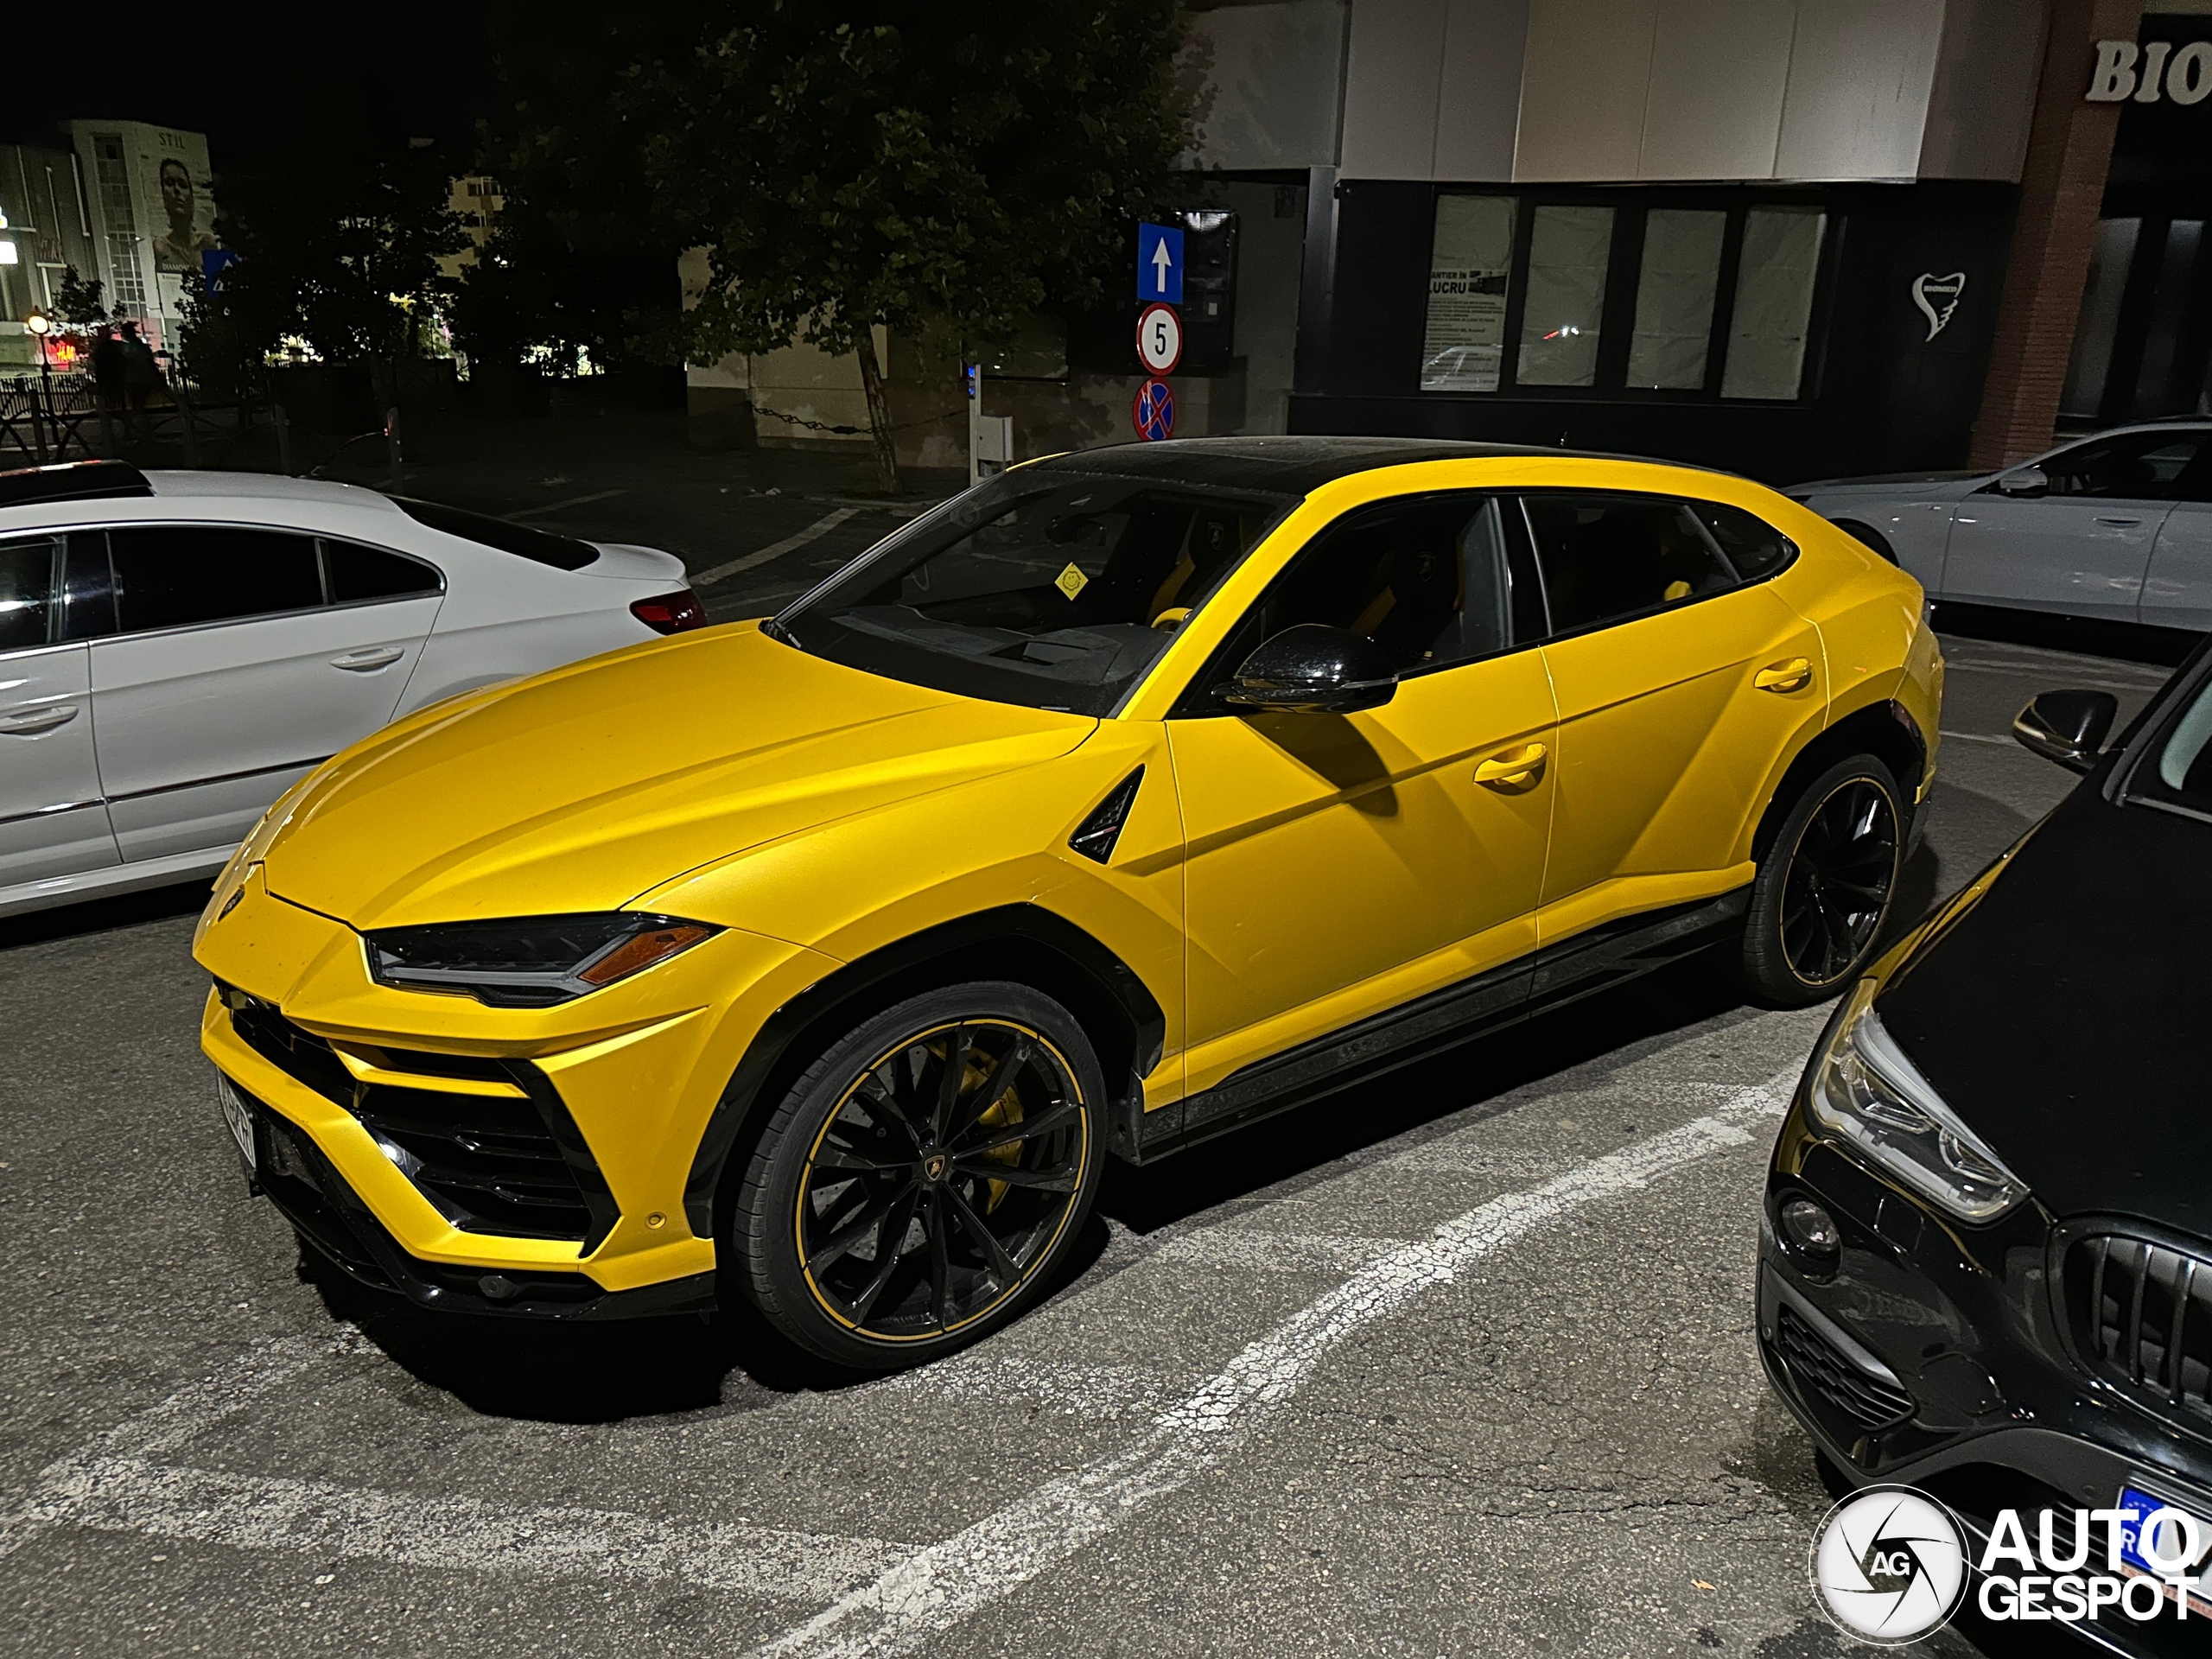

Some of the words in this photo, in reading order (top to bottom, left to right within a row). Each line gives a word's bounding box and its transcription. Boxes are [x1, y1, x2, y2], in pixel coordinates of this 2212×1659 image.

[2085, 40, 2212, 105] BIO
[159, 131, 185, 149] STIL
[1155, 322, 1166, 355] 5
